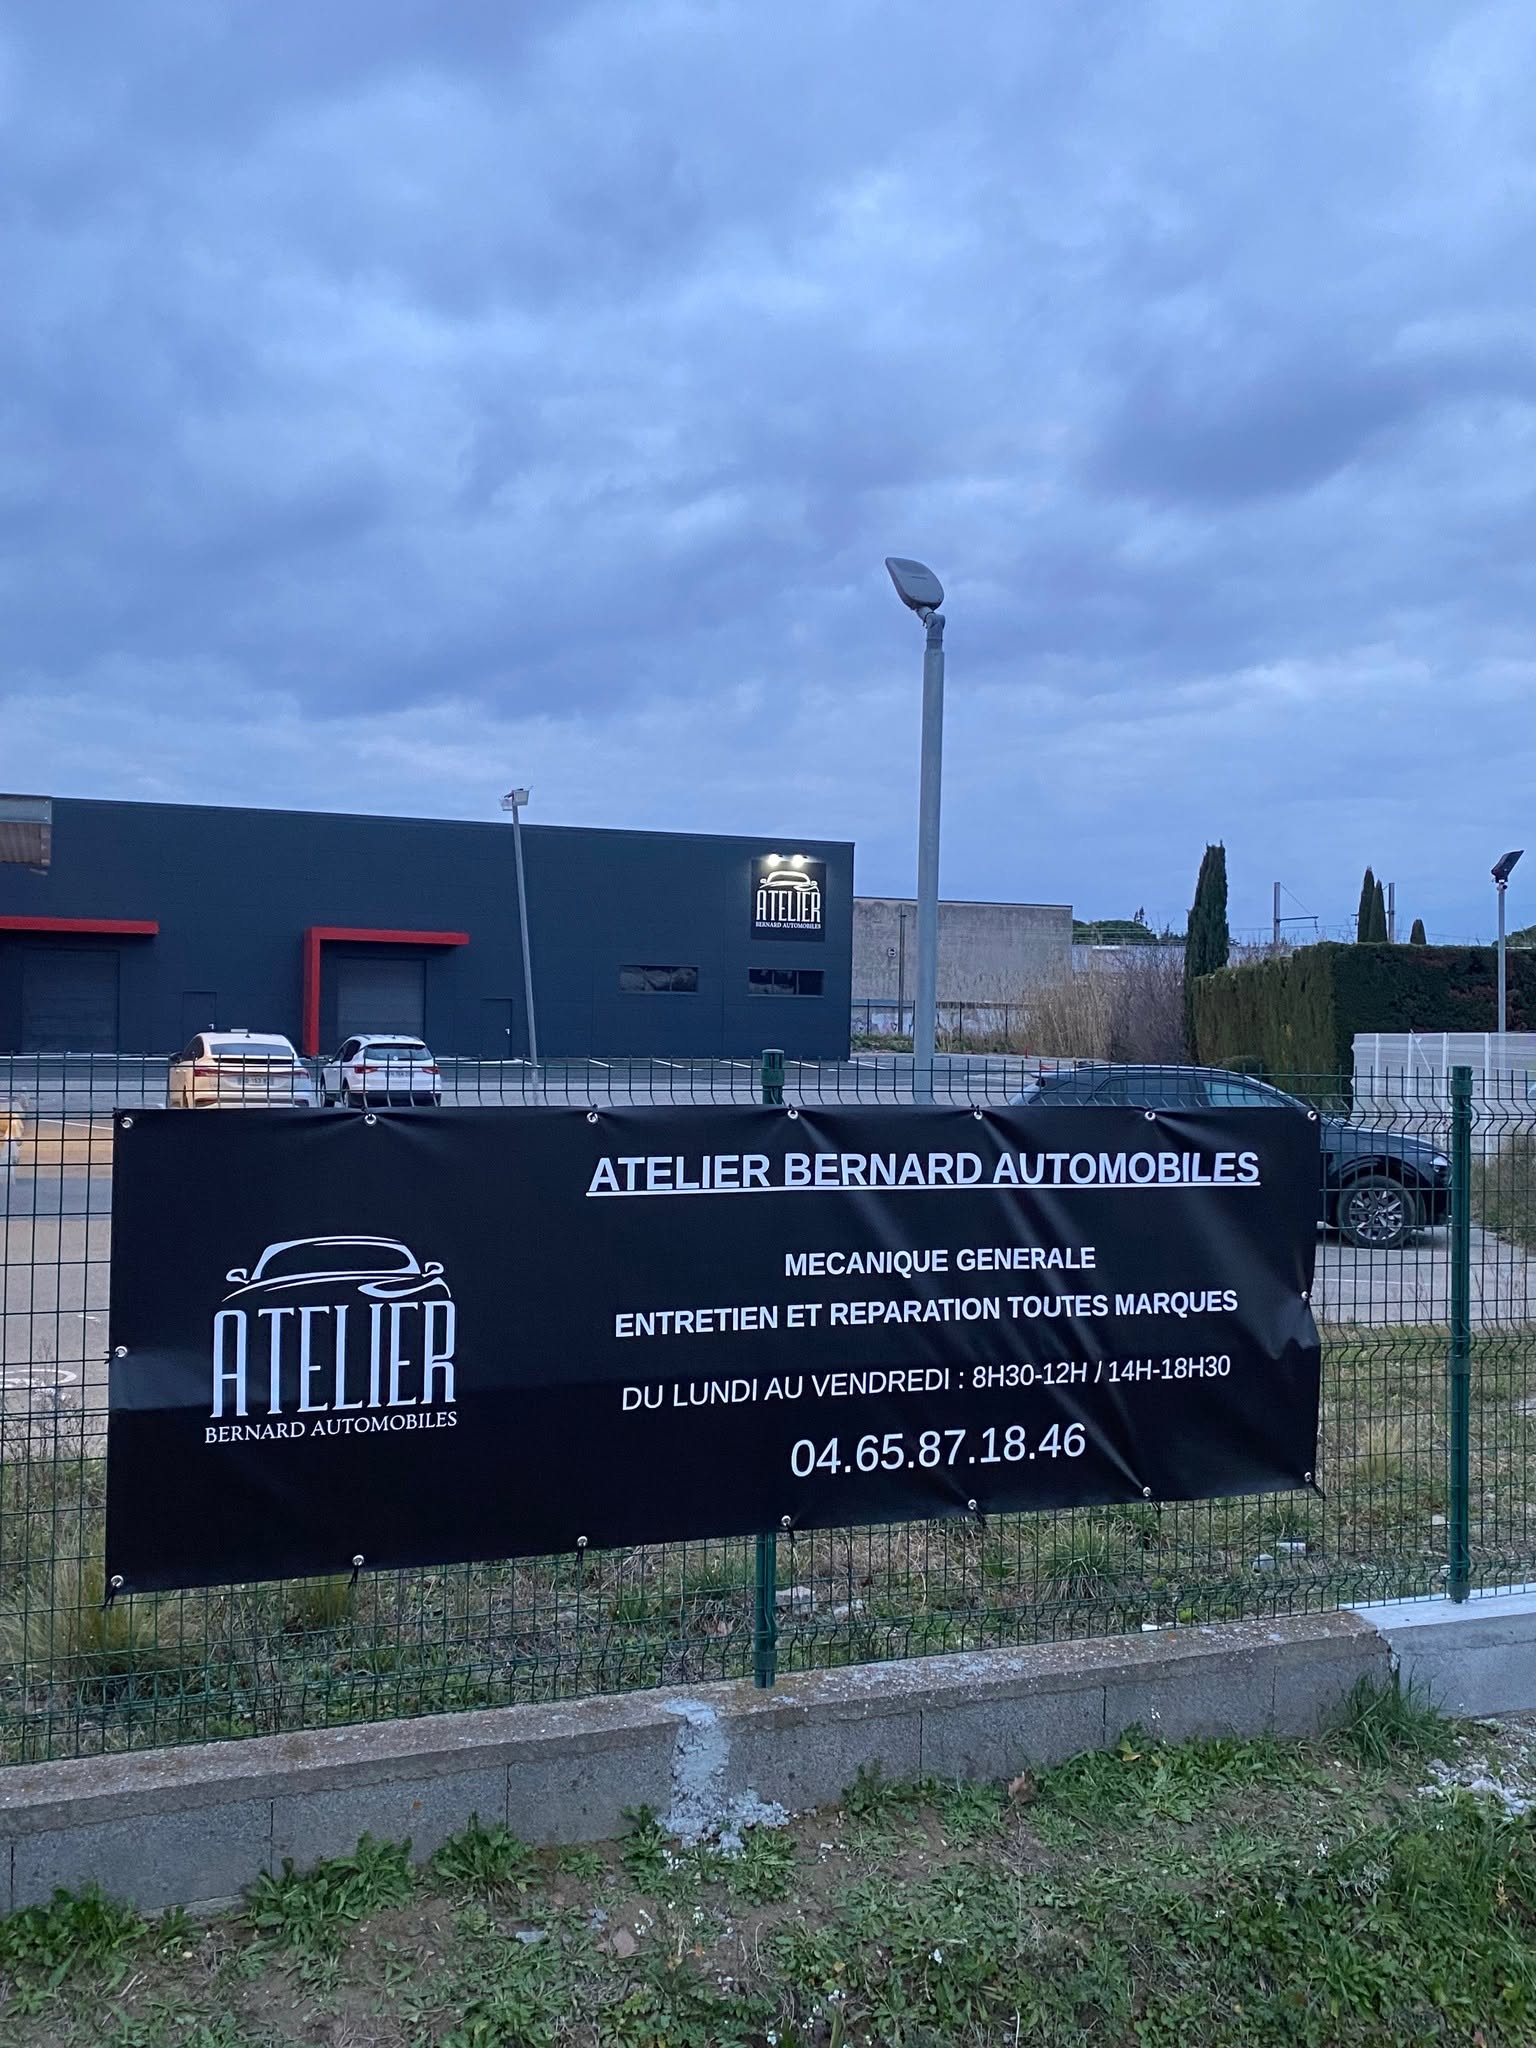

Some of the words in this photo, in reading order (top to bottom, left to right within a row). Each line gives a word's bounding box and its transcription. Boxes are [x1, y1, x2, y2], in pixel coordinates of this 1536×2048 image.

[756, 890, 821, 922] ATELIER
[588, 1156, 771, 1193] ATELIER
[784, 1153, 983, 1187] BERNARD
[992, 1152, 1260, 1184] AUTOMOBILES
[785, 1250, 949, 1278] MECANIQUE
[956, 1247, 1096, 1272] GENERALE
[615, 1306, 778, 1338] ENTRETIEN
[787, 1304, 823, 1328] ET
[830, 1299, 1000, 1326] REPARATION
[1007, 1295, 1109, 1319] TOUTES
[1115, 1290, 1238, 1319] MARQUES
[209, 1301, 457, 1418] ATELIER
[622, 1386, 663, 1411] DU
[673, 1378, 758, 1407] LUNDI
[764, 1375, 803, 1401] AU
[812, 1367, 950, 1397] VENDREDI
[972, 1362, 1088, 1389] 8H30-12H
[1108, 1355, 1231, 1383] 14H-18H30
[204, 1421, 306, 1444] BERNARD
[310, 1410, 458, 1437] AUTOMOBILES
[791, 1422, 1086, 1477] 04.65.87.18.46
